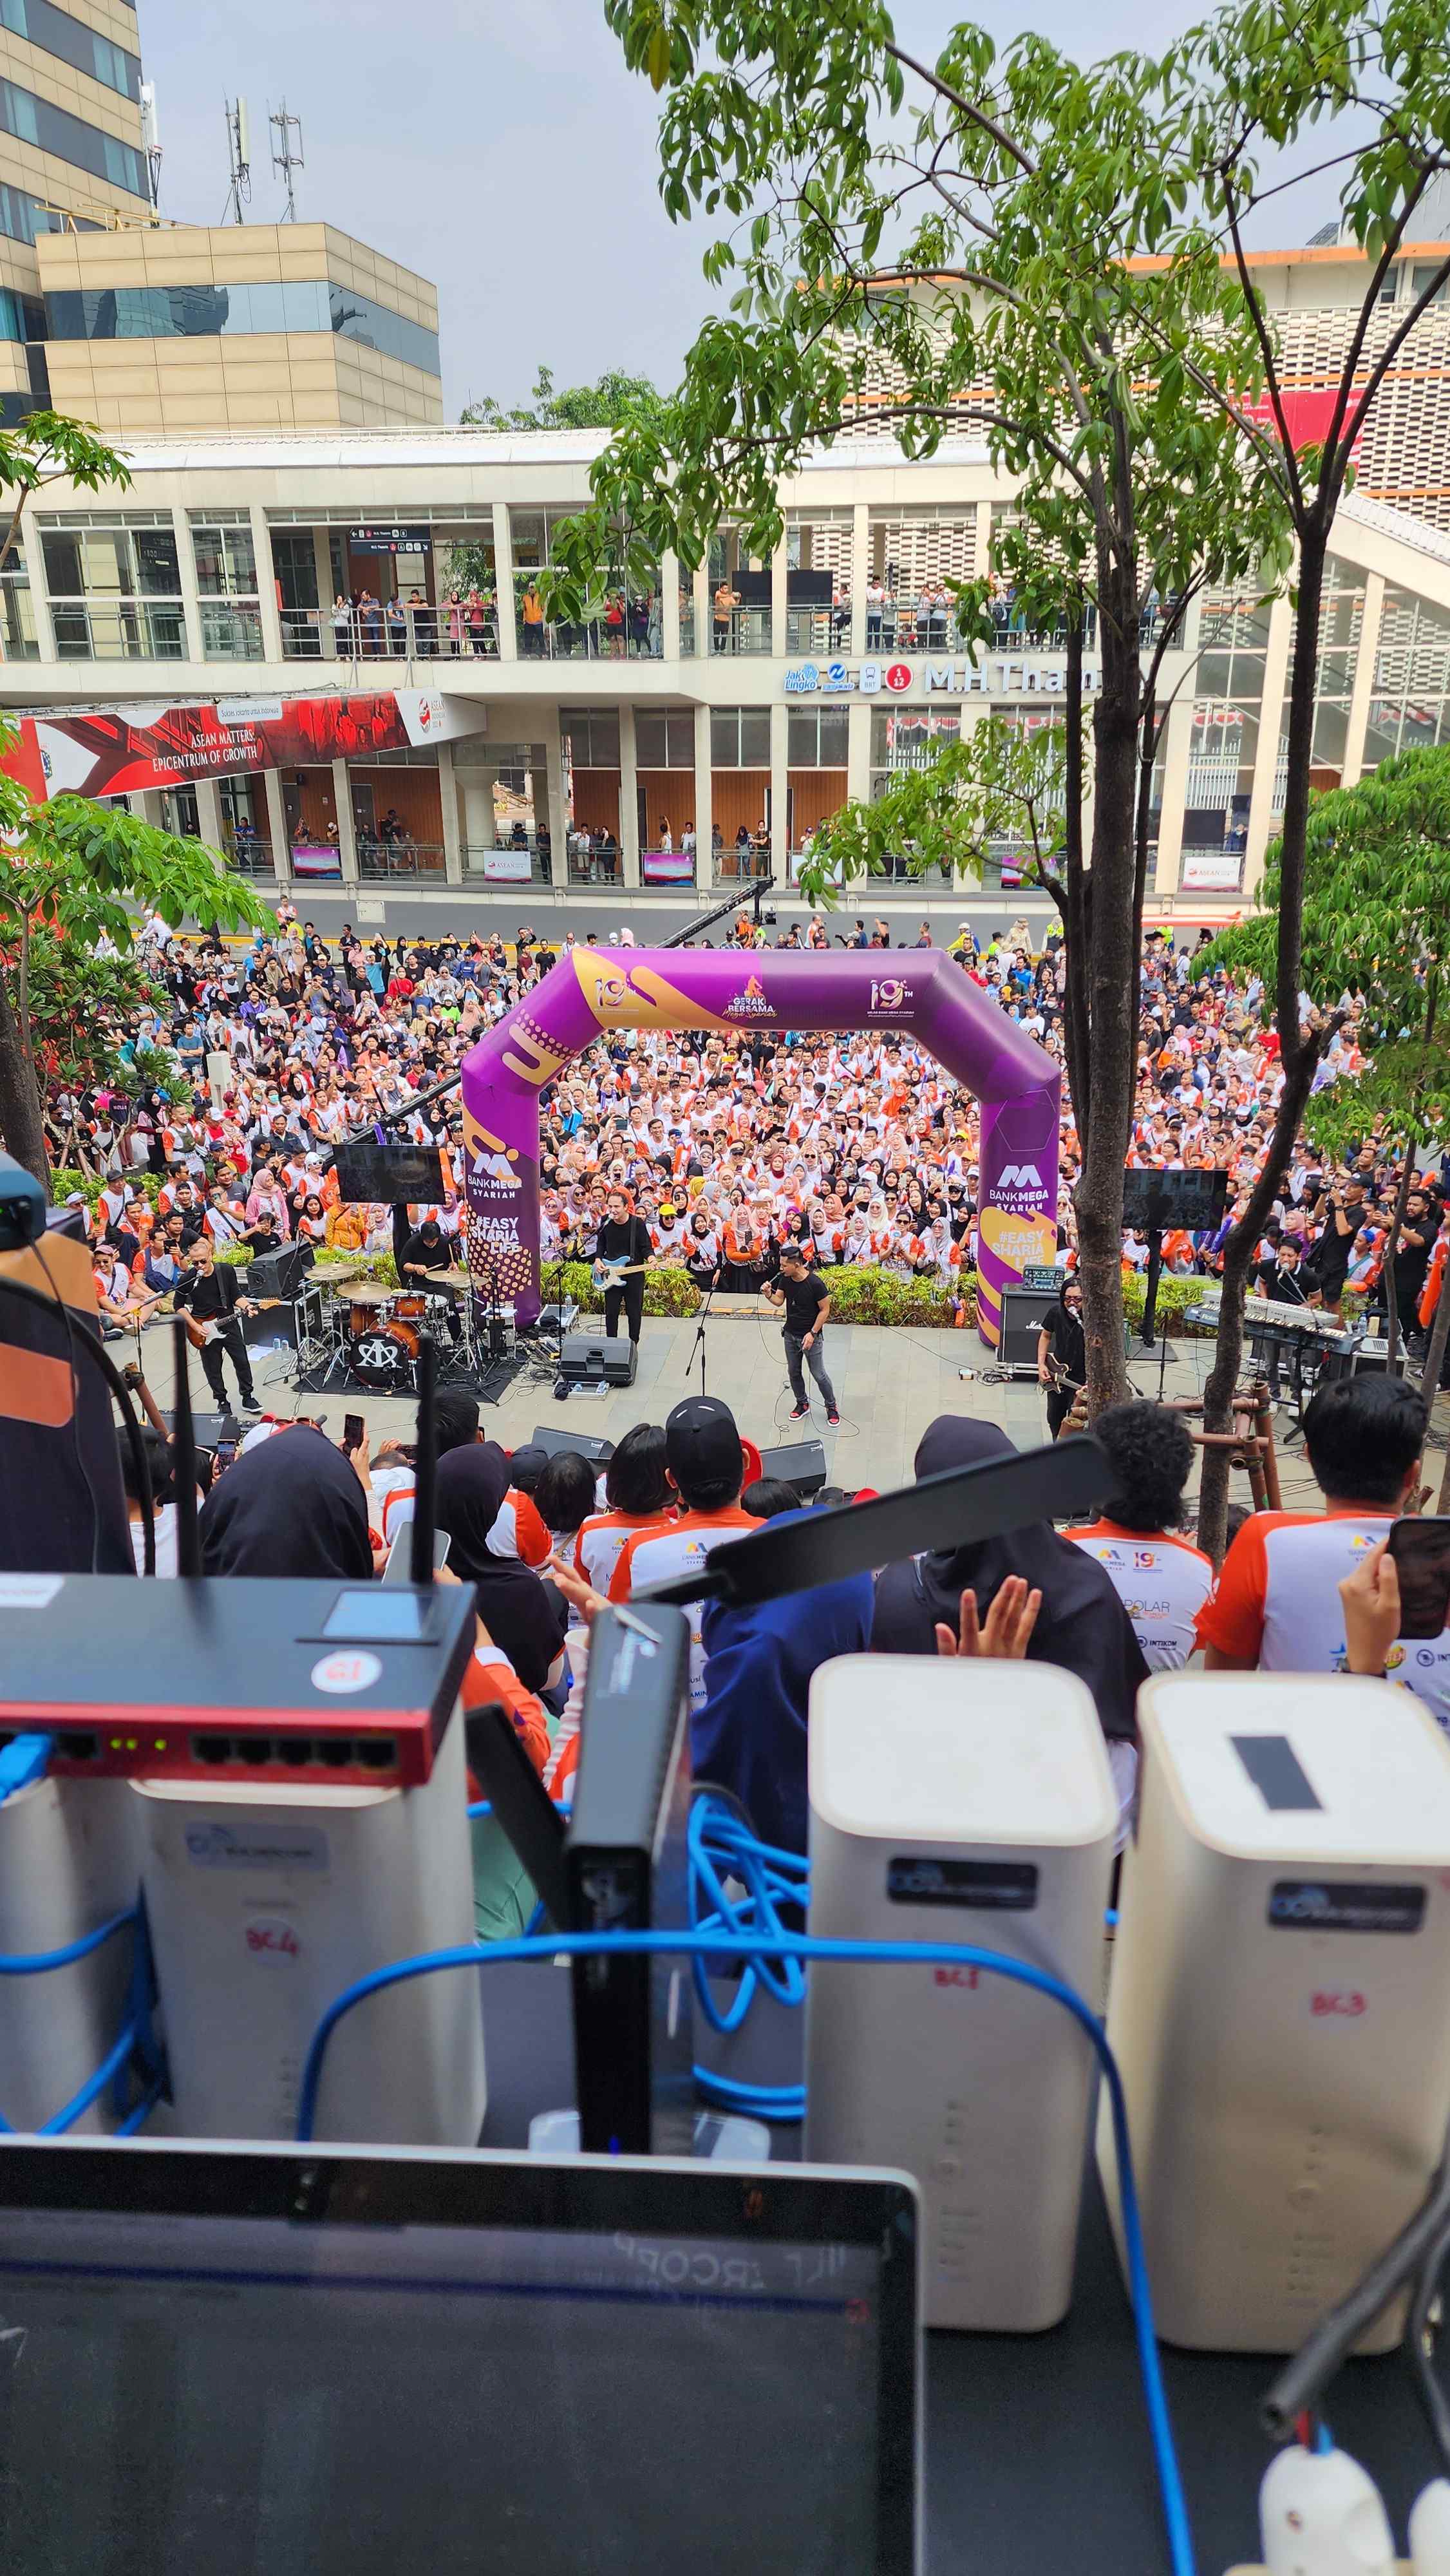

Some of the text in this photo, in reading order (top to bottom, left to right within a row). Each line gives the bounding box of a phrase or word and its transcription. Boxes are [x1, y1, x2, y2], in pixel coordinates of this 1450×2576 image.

[786, 670, 802, 681] Jak
[896, 667, 902, 677] 1
[785, 679, 817, 692] Lingko
[893, 677, 905, 687] 12
[191, 729, 256, 748] ASEAN MATTERS:
[152, 745, 258, 772] EPICENTRUM OF GROWTH
[733, 997, 764, 1005] GERAK
[870, 979, 903, 1010] 19
[473, 1188, 515, 1198] SYARIAH
[990, 1189, 1049, 1202] BANKMEGA
[996, 1202, 1043, 1212] SYARIAH
[476, 1215, 519, 1230] #EASY
[471, 1226, 519, 1242] SHARIA
[999, 1230, 1044, 1244] #EASY
[490, 1240, 520, 1253] LIFE
[993, 1243, 1044, 1256] SHARIA
[1133, 1552, 1154, 1567] 19
[1124, 1598, 1170, 1613] POLAR
